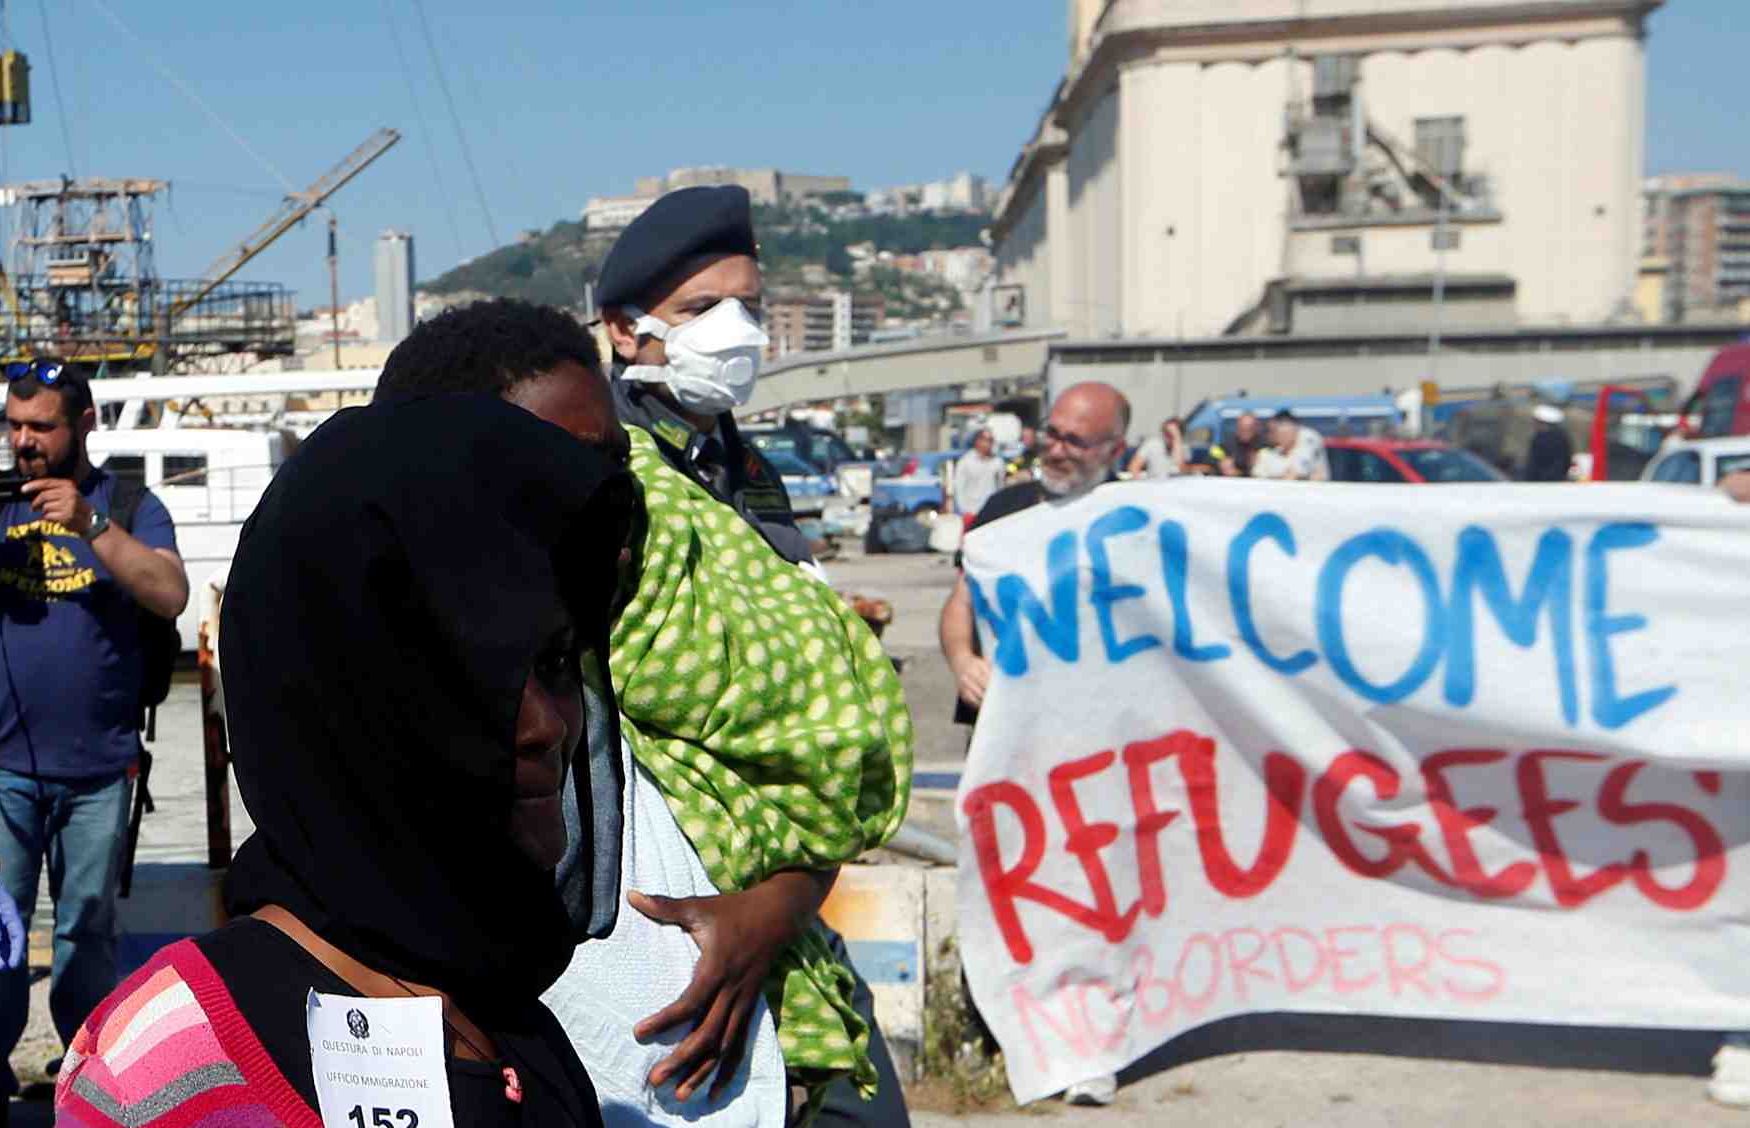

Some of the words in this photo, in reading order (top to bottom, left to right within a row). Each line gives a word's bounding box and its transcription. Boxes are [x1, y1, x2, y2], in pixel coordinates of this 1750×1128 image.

[969, 504, 1680, 729] WELCOME
[963, 729, 1729, 964] REFUGEES
[322, 1039, 368, 1056] QUESTURA
[372, 1047, 382, 1056] DI
[386, 1047, 425, 1057] NAPOLI
[1007, 970, 1136, 1073] NO
[1132, 923, 1507, 1026] BORDERS
[327, 1071, 360, 1085] UFFICIO
[360, 1075, 430, 1089] IMMIGRAZIONE
